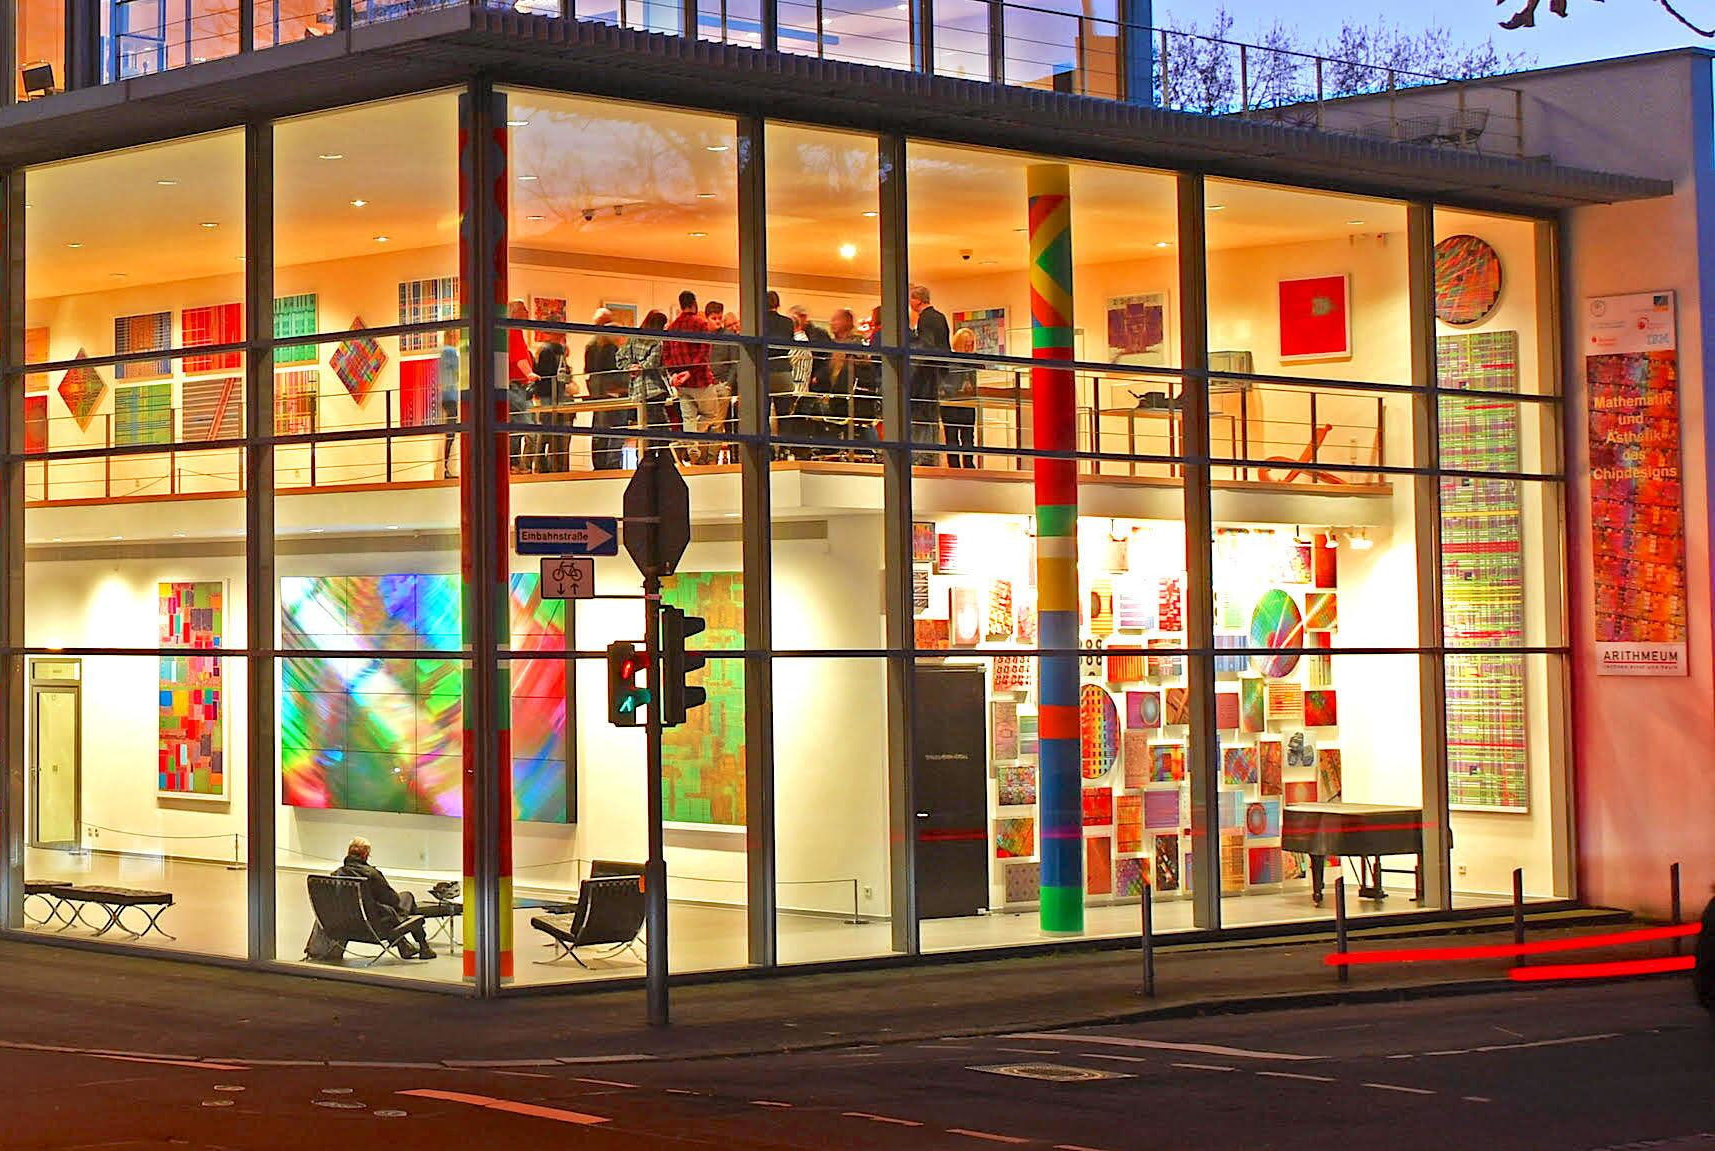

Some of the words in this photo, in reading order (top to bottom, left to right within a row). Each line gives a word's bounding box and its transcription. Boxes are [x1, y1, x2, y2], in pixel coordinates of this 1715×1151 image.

[1593, 390, 1673, 408] Mathematik
[1618, 412, 1644, 425] und
[1605, 428, 1661, 444] Ästhetik
[1593, 466, 1677, 482] Chipdesigns
[521, 531, 589, 541] Einbahnstraße
[1604, 650, 1677, 660] ARITHMEUM
